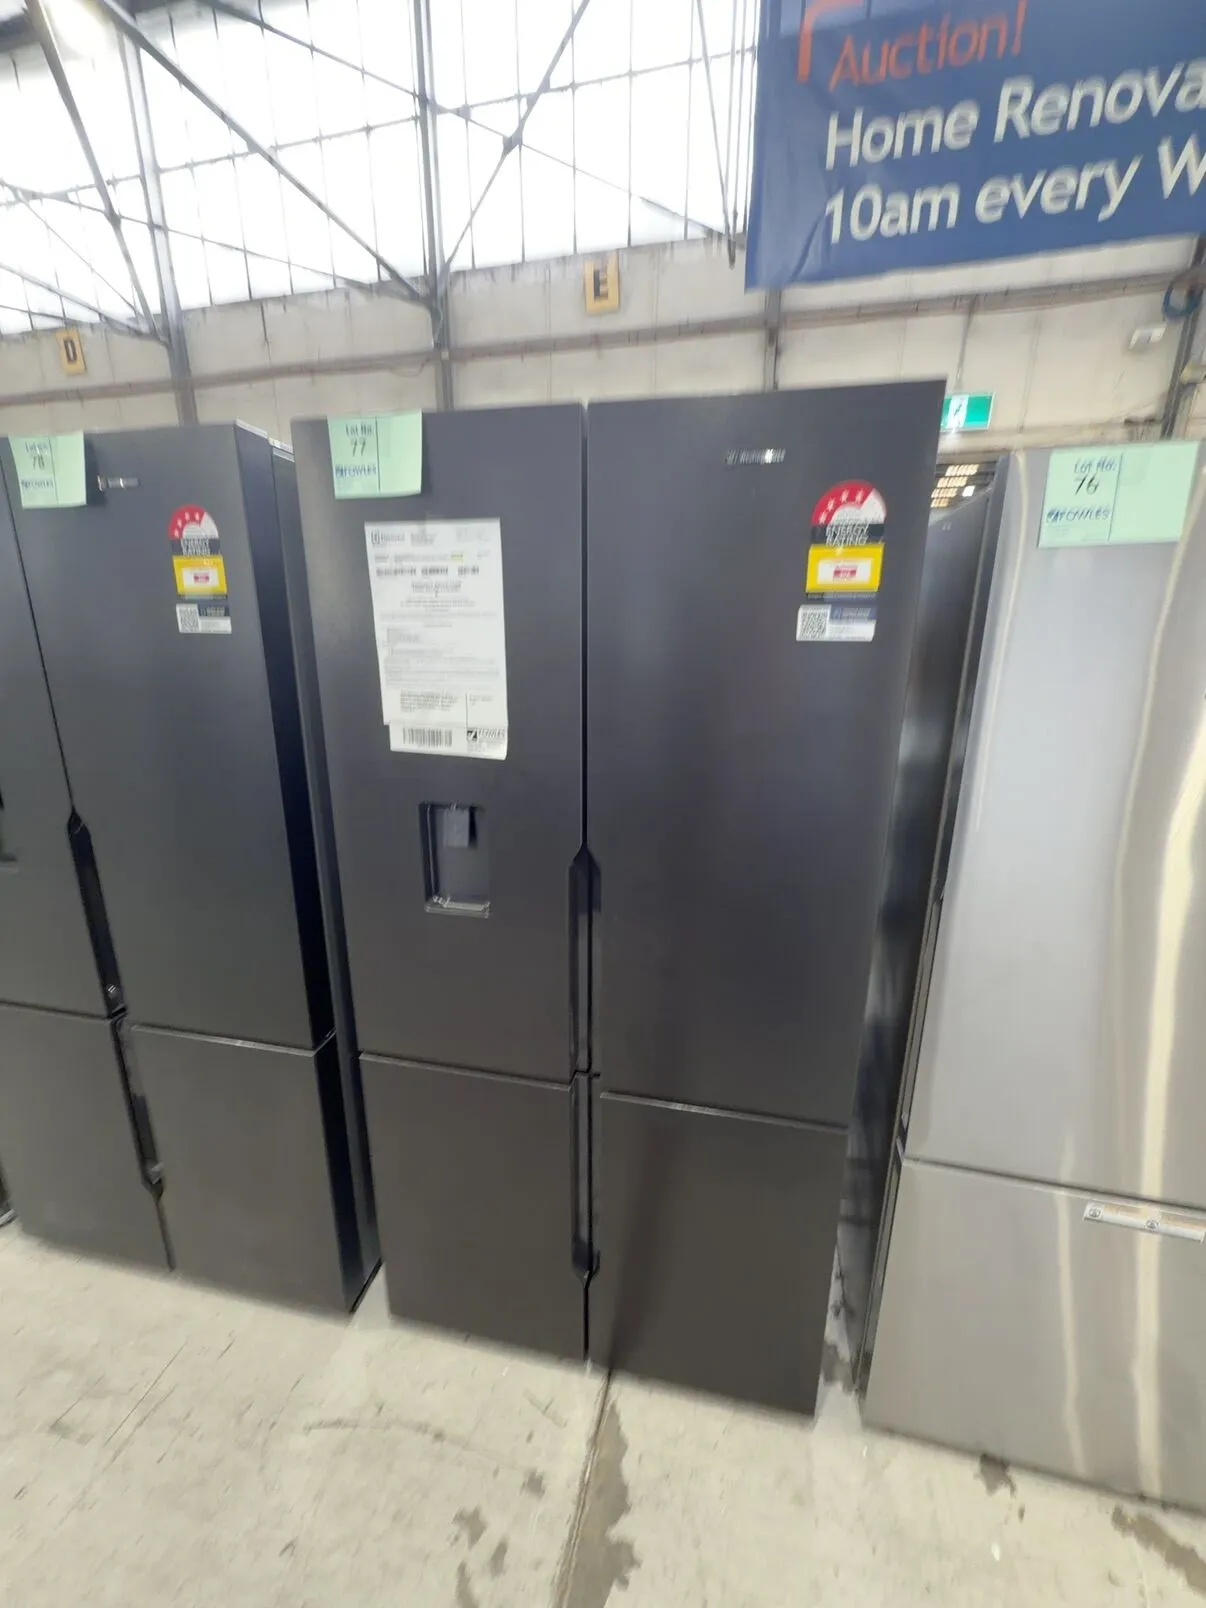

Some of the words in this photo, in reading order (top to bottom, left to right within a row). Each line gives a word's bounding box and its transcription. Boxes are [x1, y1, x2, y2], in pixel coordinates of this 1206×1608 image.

[825, 100, 980, 170] Home
[994, 57, 1206, 143] Renova
[826, 183, 961, 244] 10am
[975, 155, 1143, 223] every
[351, 438, 366, 456] 77
[1074, 471, 1100, 495] 76
